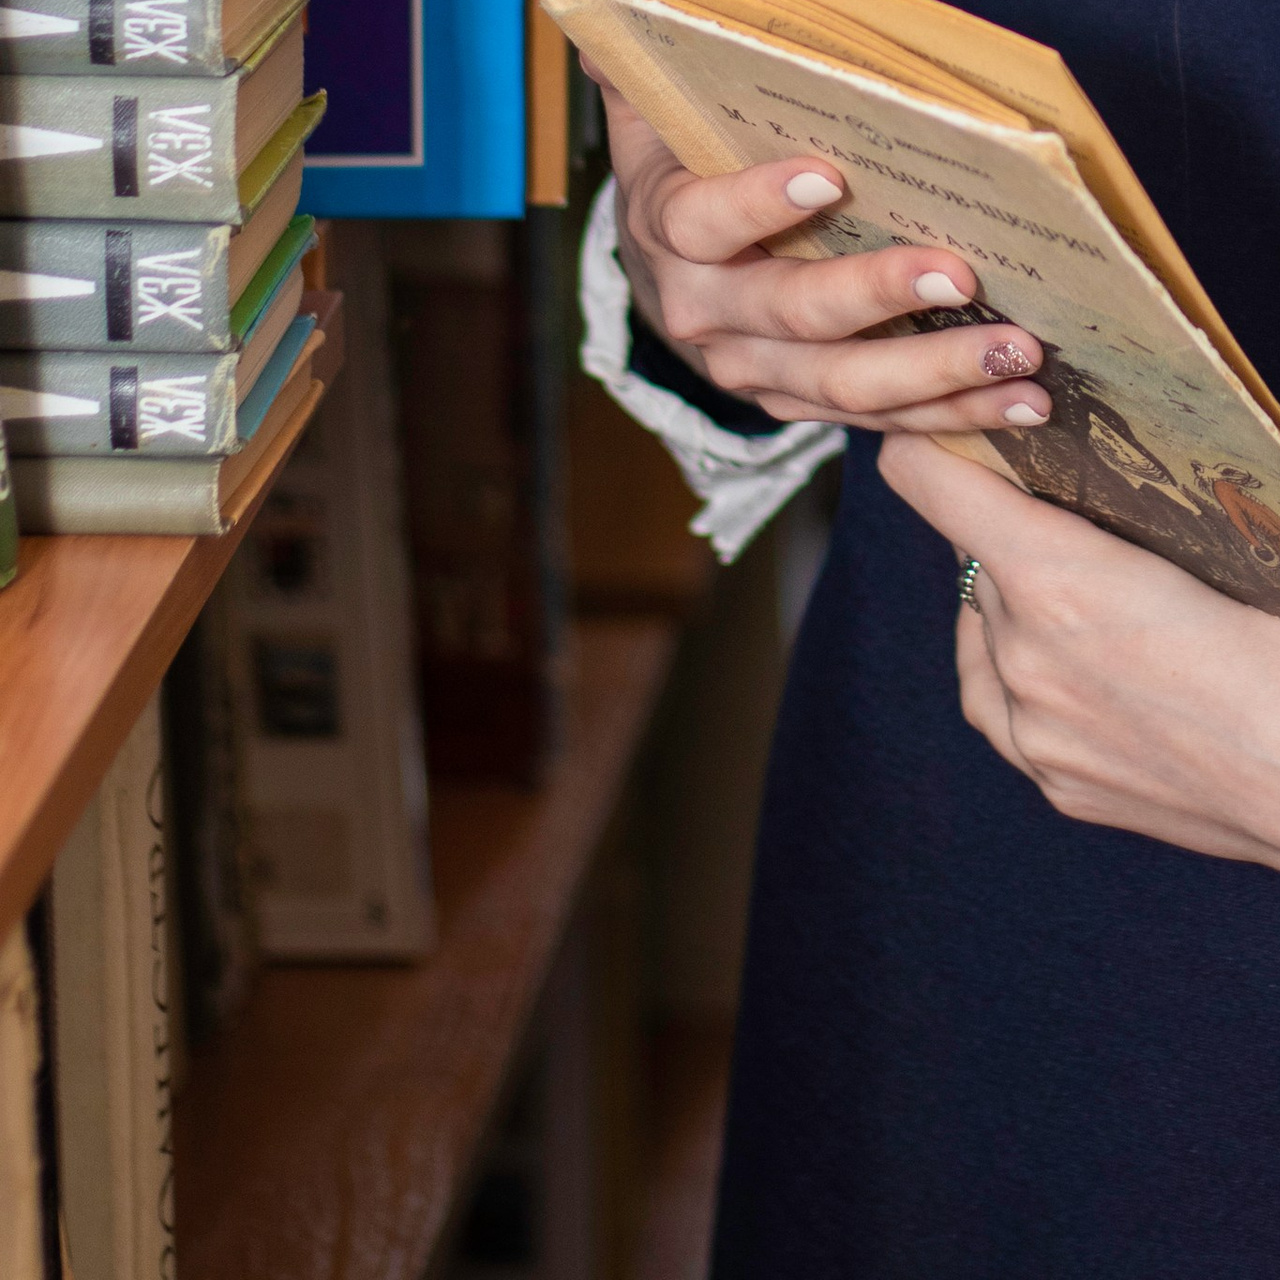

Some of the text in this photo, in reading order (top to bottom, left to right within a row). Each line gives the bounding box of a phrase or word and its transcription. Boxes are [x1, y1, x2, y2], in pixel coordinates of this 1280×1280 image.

[717, 102, 757, 127] М.
[766, 119, 798, 141] Е.
[889, 211, 1045, 281] СКАЗКИ
